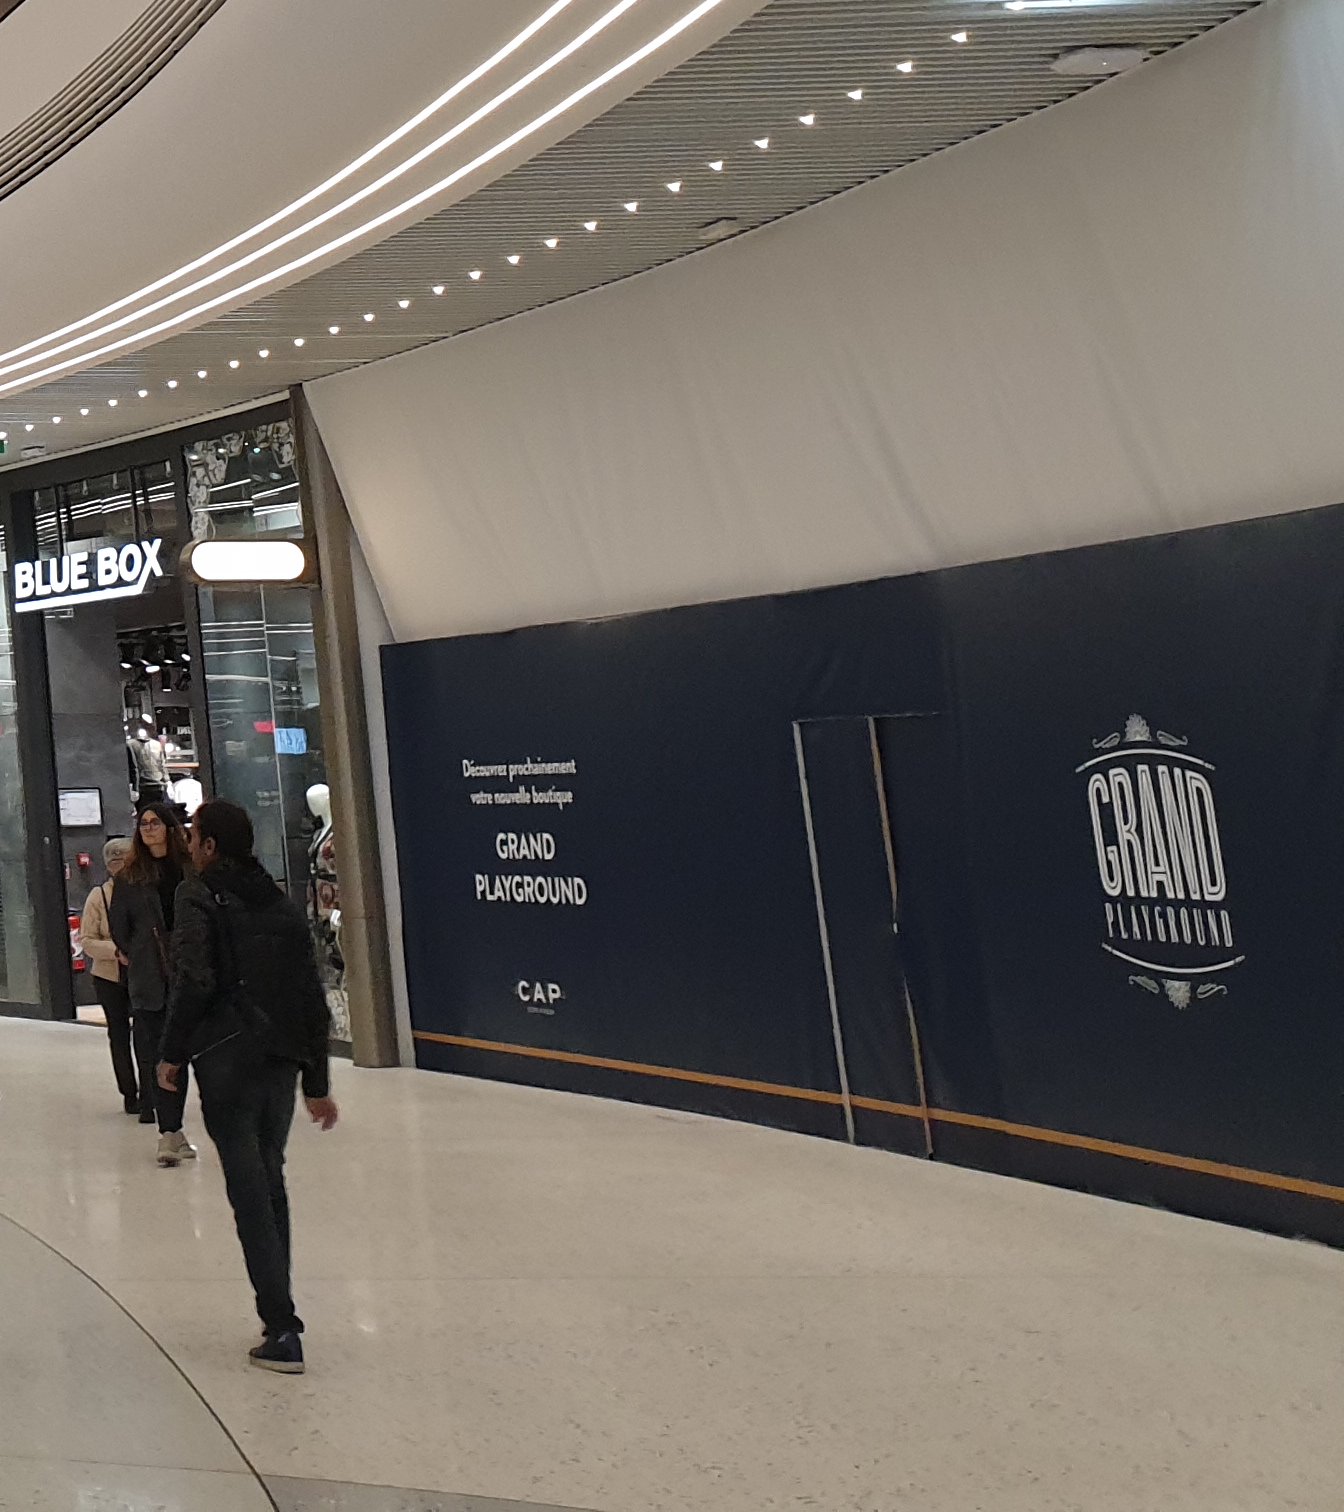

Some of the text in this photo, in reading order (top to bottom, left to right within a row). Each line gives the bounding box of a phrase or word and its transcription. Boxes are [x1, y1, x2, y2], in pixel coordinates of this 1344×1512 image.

[14, 538, 163, 600] BLUE BOX
[462, 756, 577, 783] Découvrez prochainement
[470, 785, 574, 811] votre nouvelle boutique
[495, 832, 556, 861] GRAND
[1087, 763, 1227, 902] GRAND
[475, 873, 588, 906] PLAYGROUND
[1105, 902, 1234, 948] PLAYGROUND
[517, 980, 562, 1004] CAP
